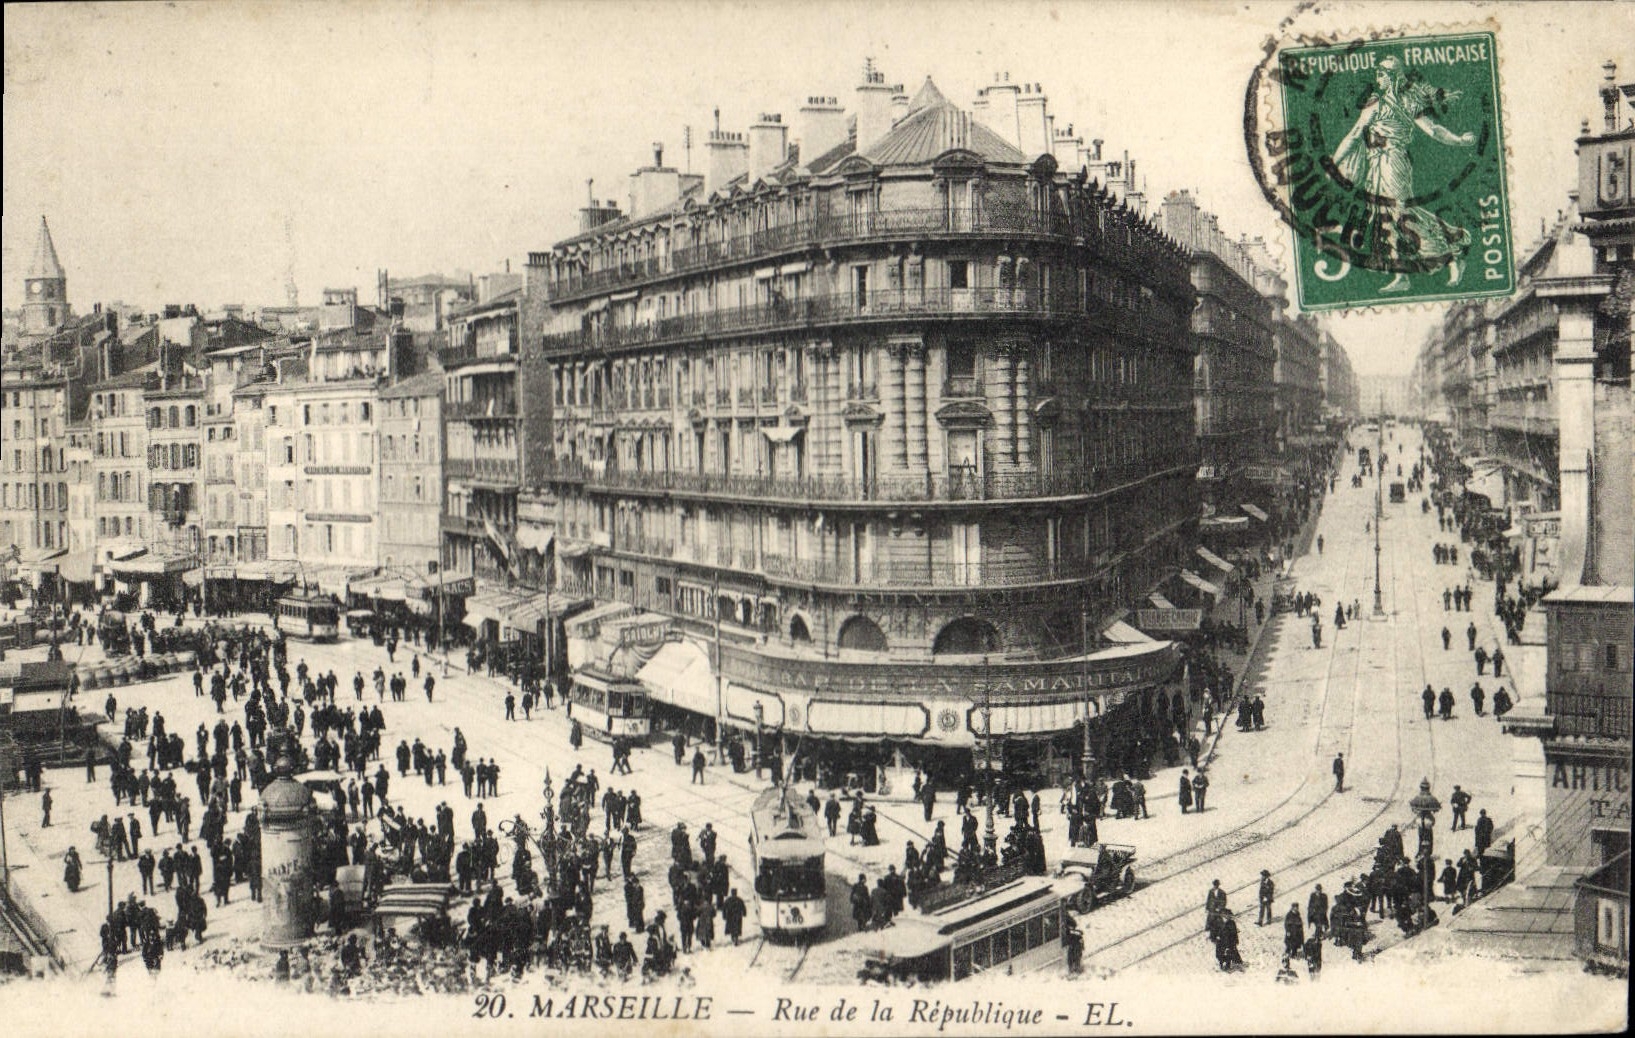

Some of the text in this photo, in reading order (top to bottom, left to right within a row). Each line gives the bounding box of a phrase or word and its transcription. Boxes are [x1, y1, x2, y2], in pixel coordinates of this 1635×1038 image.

[1403, 42, 1488, 67] FRANÇAISE
[1313, 226, 1351, 282] 5
[1478, 193, 1505, 281] POSTES
[780, 671, 829, 688] BAR
[849, 677, 888, 691] DE
